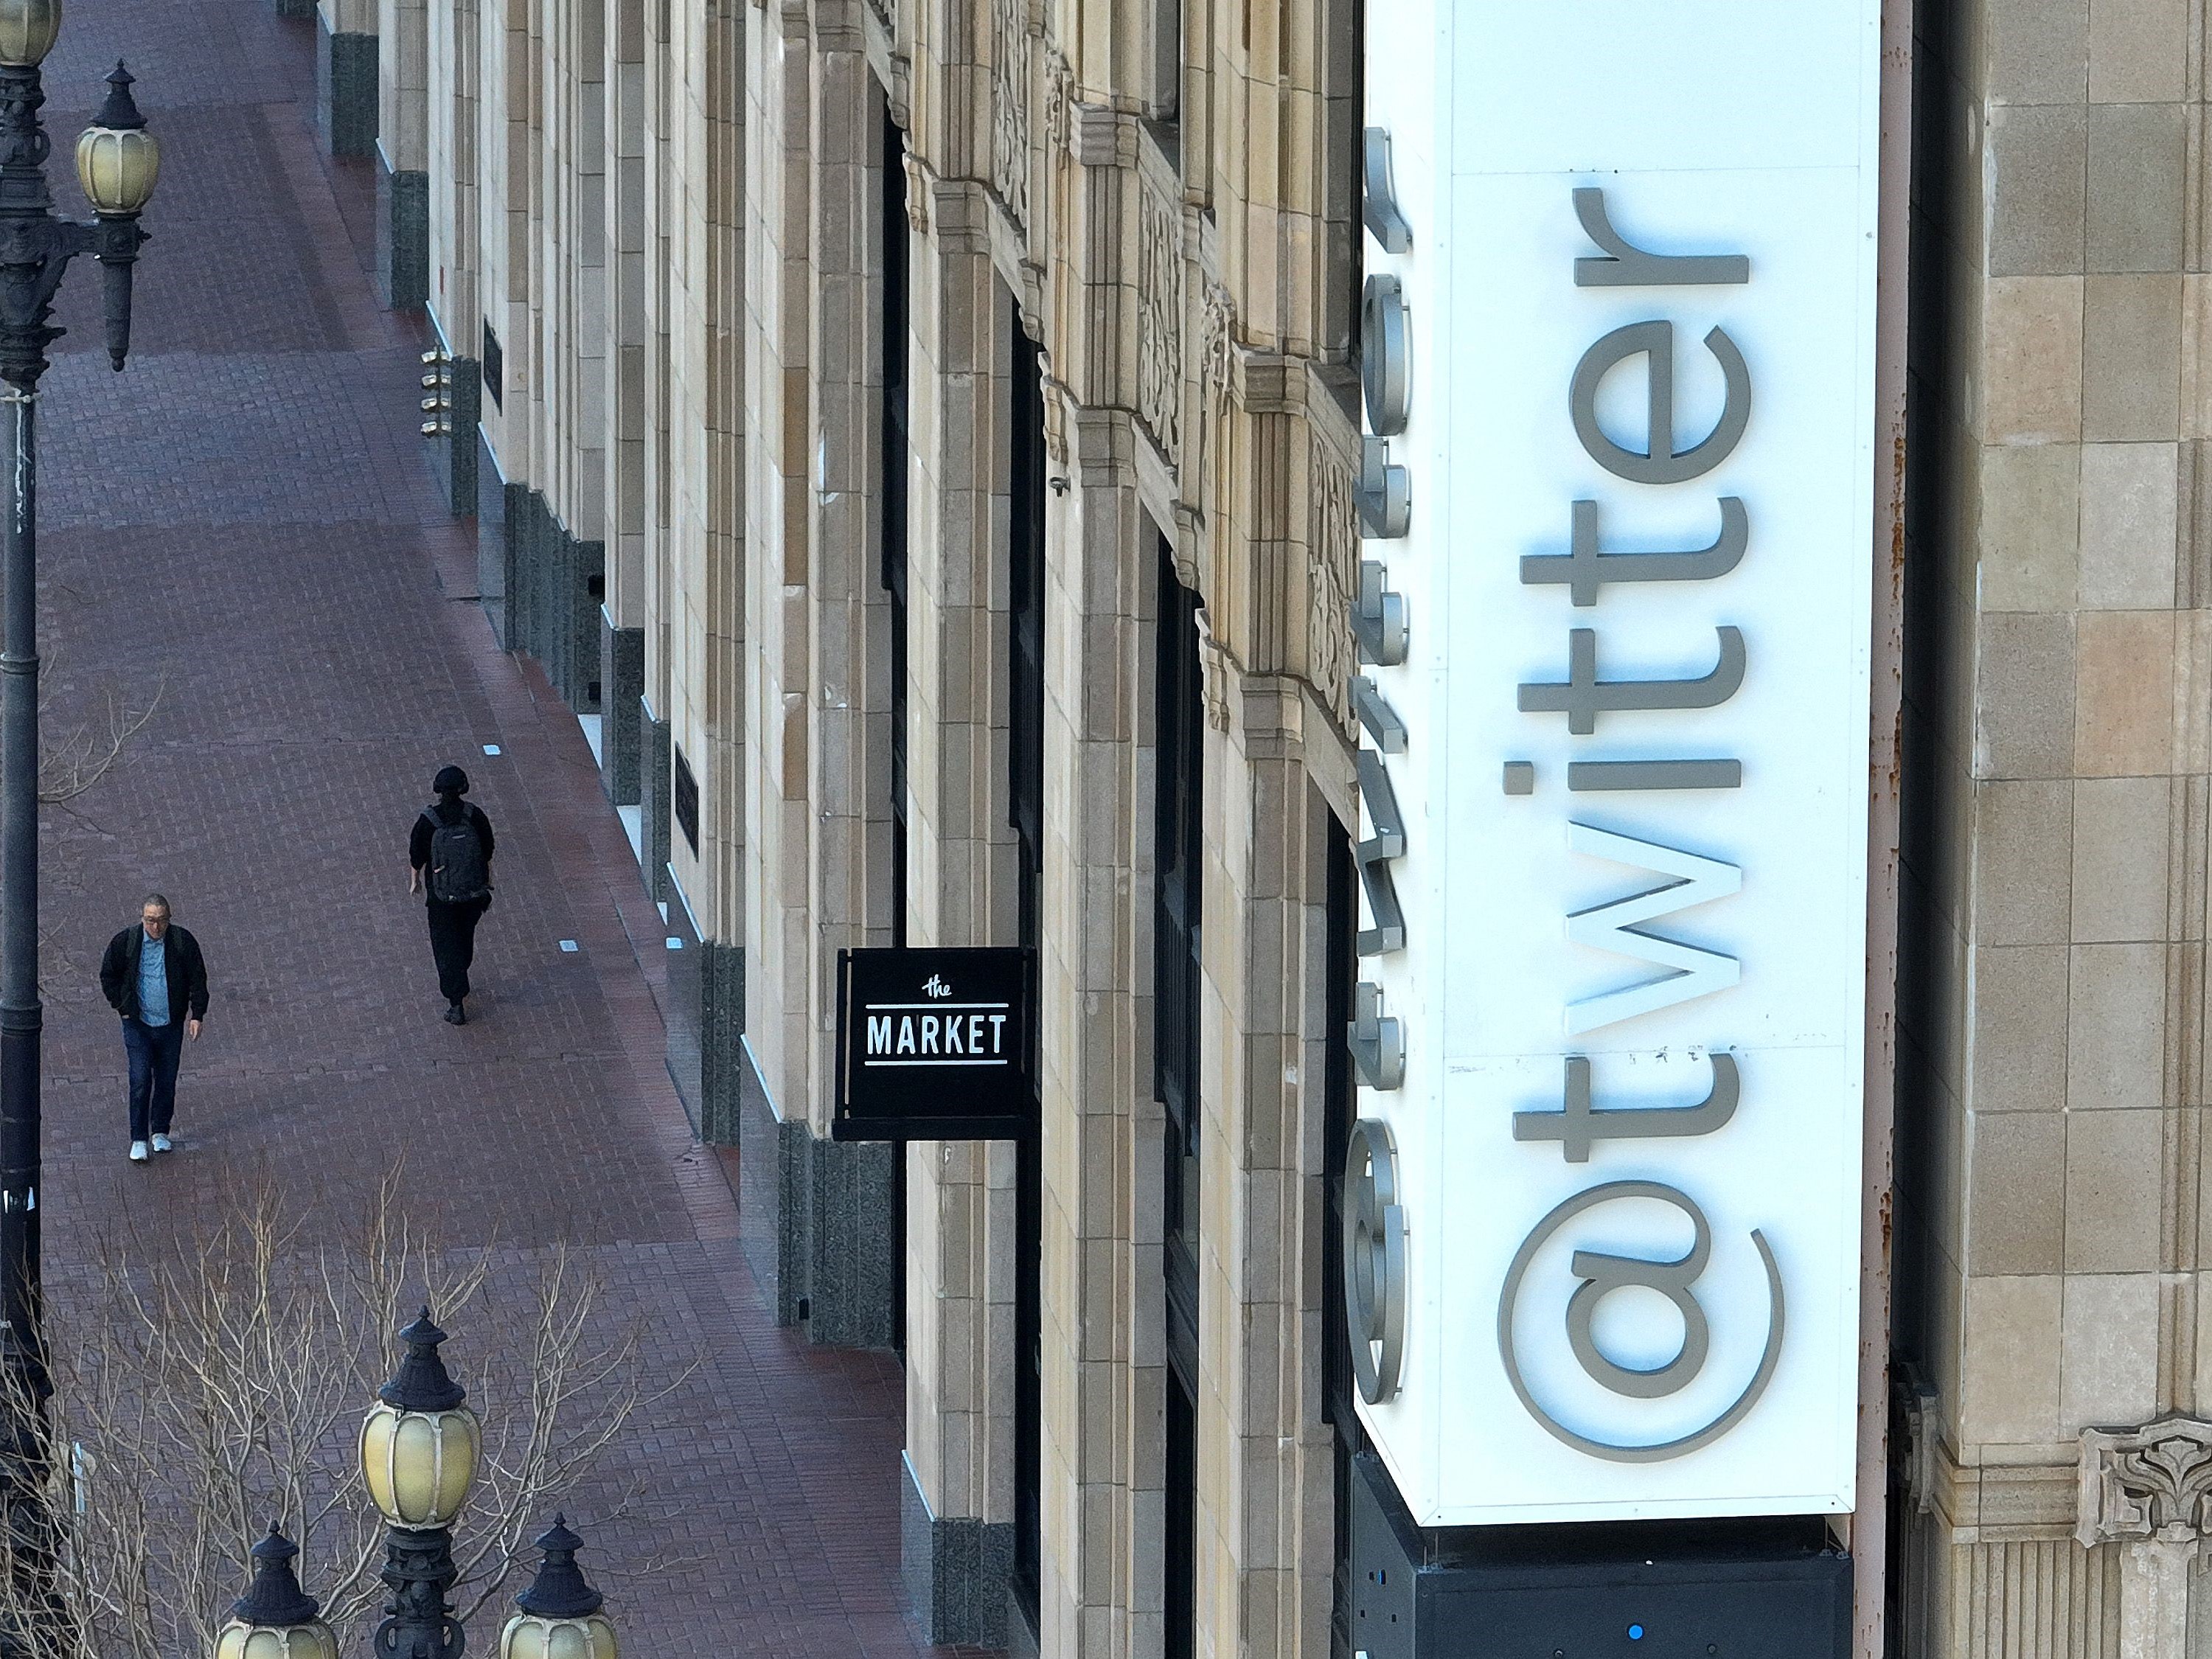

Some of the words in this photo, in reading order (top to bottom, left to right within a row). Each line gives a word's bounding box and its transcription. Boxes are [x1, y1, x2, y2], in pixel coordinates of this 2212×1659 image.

[1498, 187, 1784, 1463] @twitter
[922, 974, 952, 998] the
[867, 1015, 1006, 1054] MARKET
